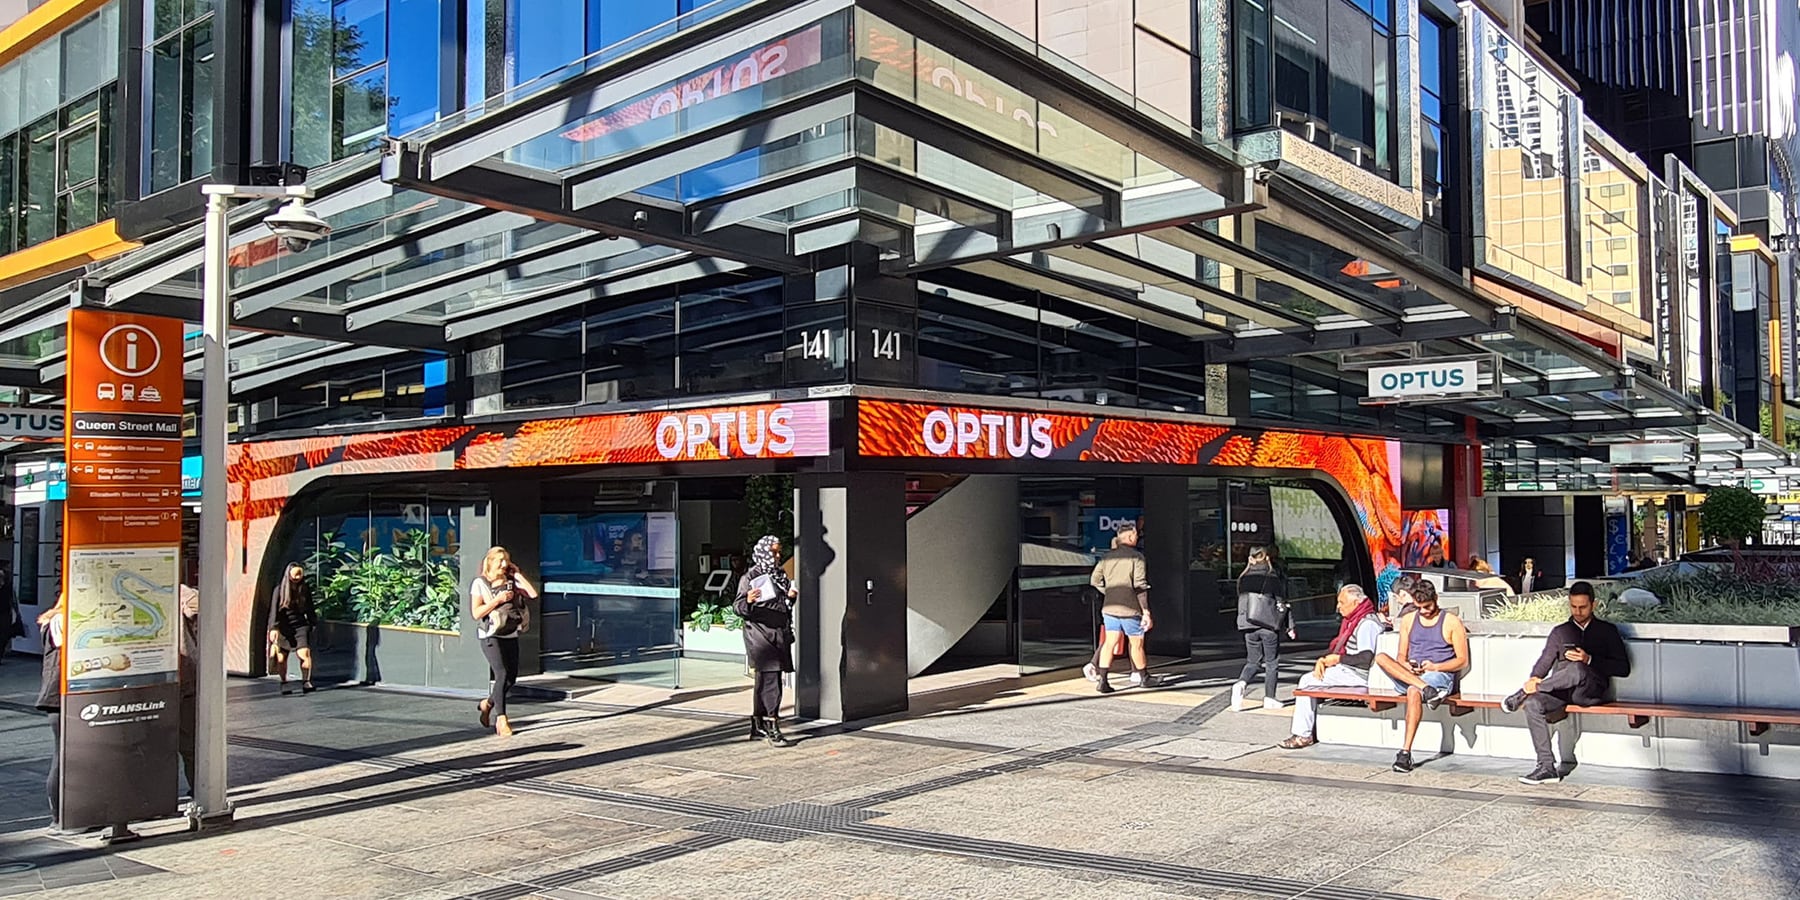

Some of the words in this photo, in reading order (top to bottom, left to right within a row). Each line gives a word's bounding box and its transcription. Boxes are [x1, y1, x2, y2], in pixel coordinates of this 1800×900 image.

[801, 329, 829, 359] 141
[872, 329, 900, 360] 141
[1381, 369, 1464, 390] OPTUS
[75, 420, 115, 431] Queen
[118, 421, 152, 431] Street
[156, 423, 178, 432] Mall
[656, 407, 795, 458] OPTUS
[922, 410, 1052, 458] OPTUS
[101, 700, 165, 716] TRANSLink
